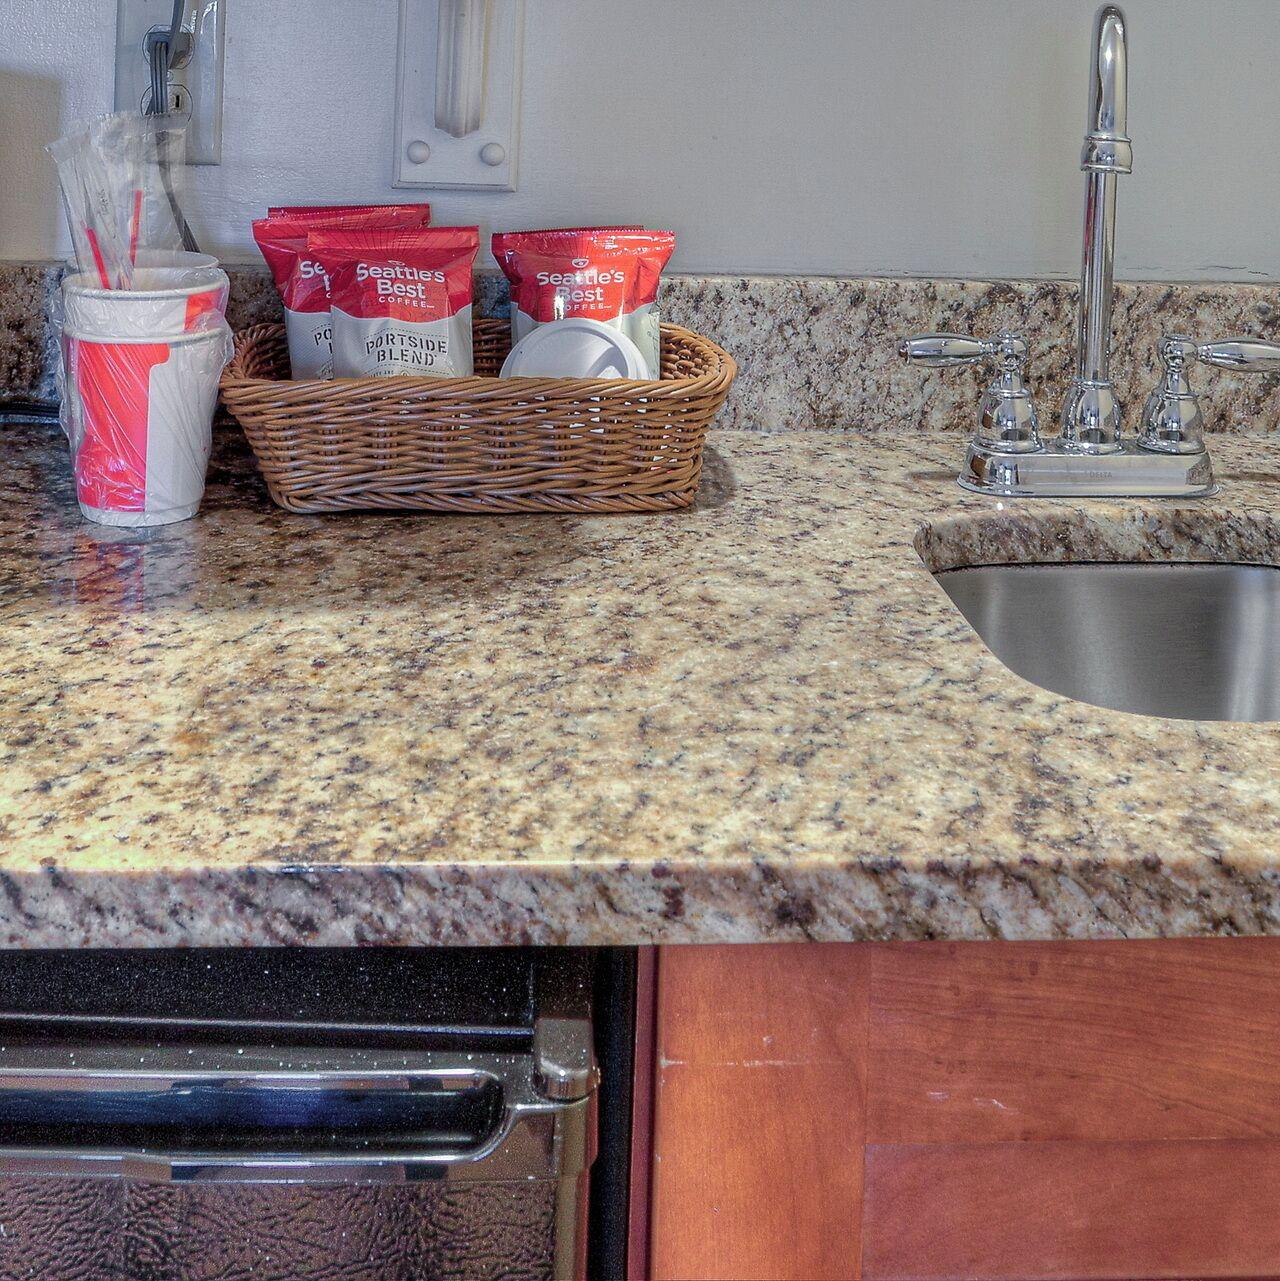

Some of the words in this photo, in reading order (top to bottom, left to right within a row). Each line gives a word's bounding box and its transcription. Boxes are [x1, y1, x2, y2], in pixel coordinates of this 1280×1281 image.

[356, 262, 446, 283] Seattle's
[536, 268, 625, 286] Seattle's
[376, 279, 426, 299] Best
[556, 286, 604, 302] Best
[378, 296, 427, 308] COFFEE
[560, 303, 605, 311] OFFEE
[366, 333, 448, 354] PORTSIDE
[377, 349, 435, 366] BLEND
